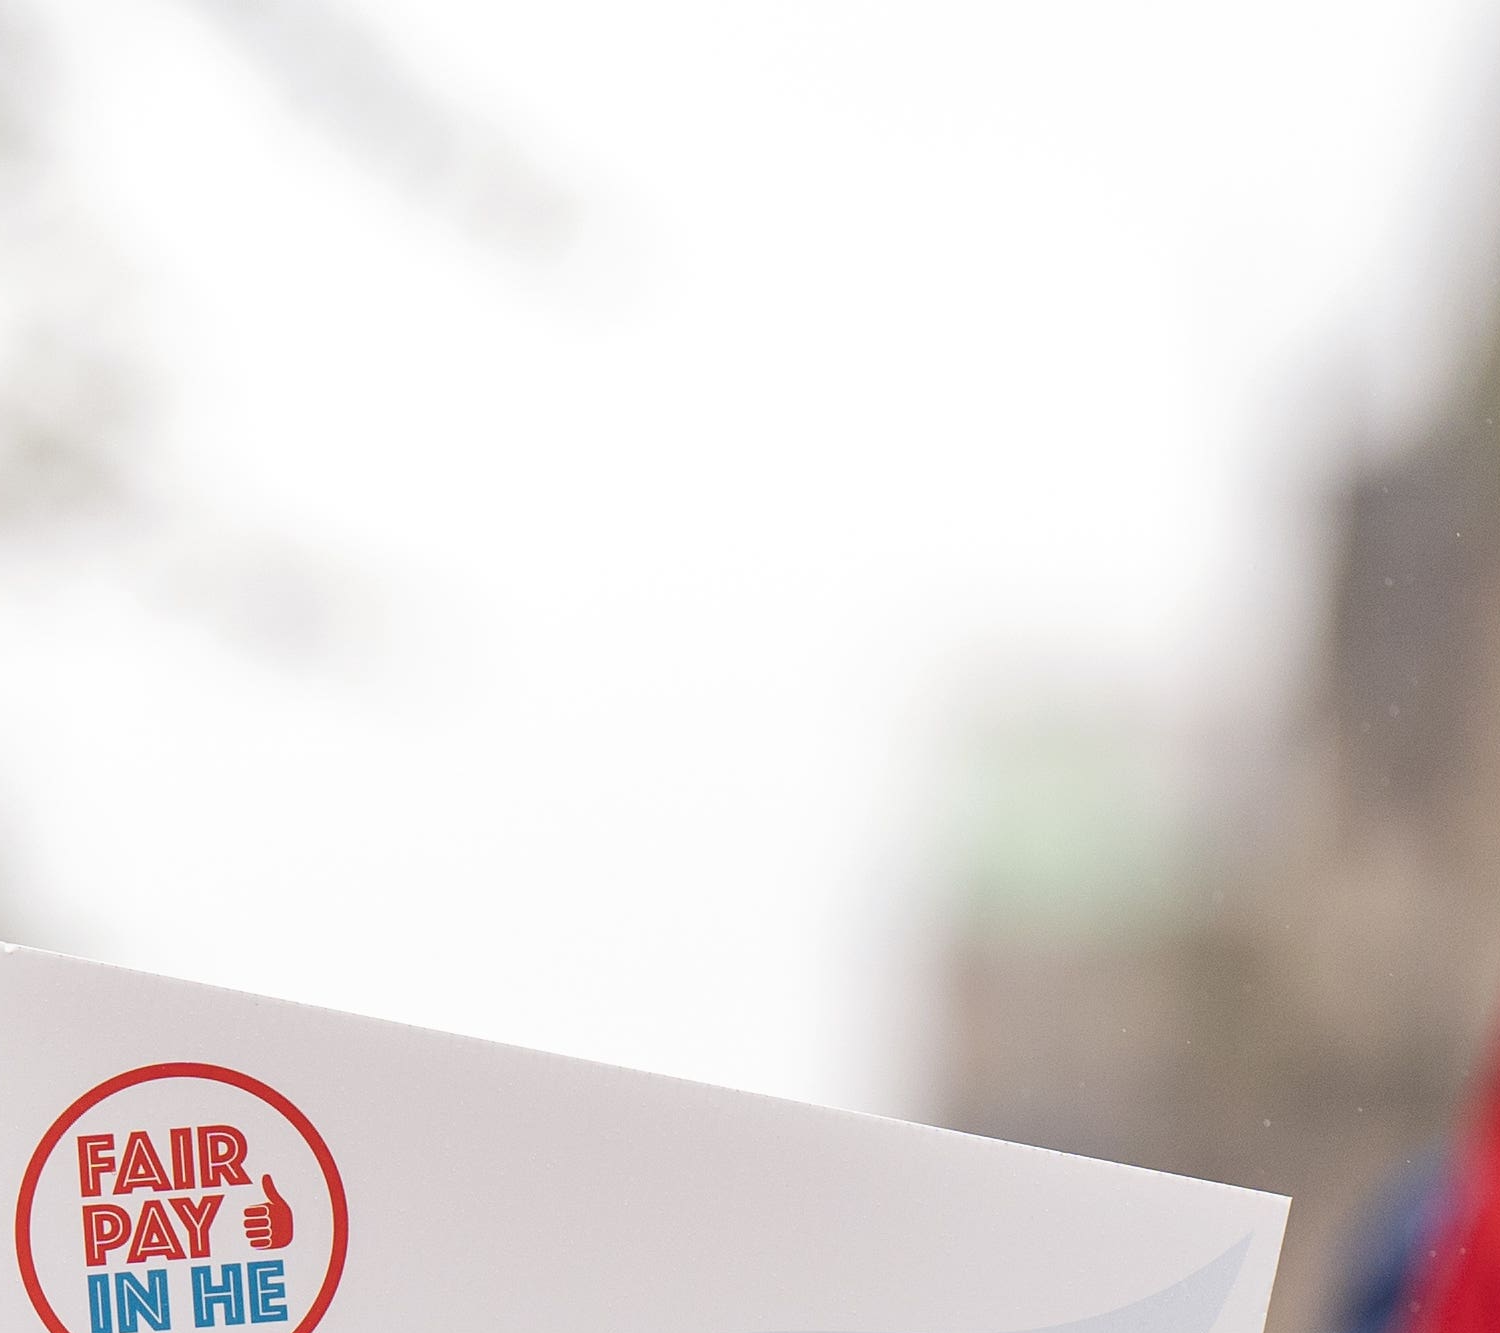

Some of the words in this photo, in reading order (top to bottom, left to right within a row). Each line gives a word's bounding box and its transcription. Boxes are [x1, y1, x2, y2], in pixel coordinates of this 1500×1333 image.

[77, 1124, 253, 1198] FAIR
[81, 1193, 225, 1267] PAY
[190, 1259, 289, 1328] HE
